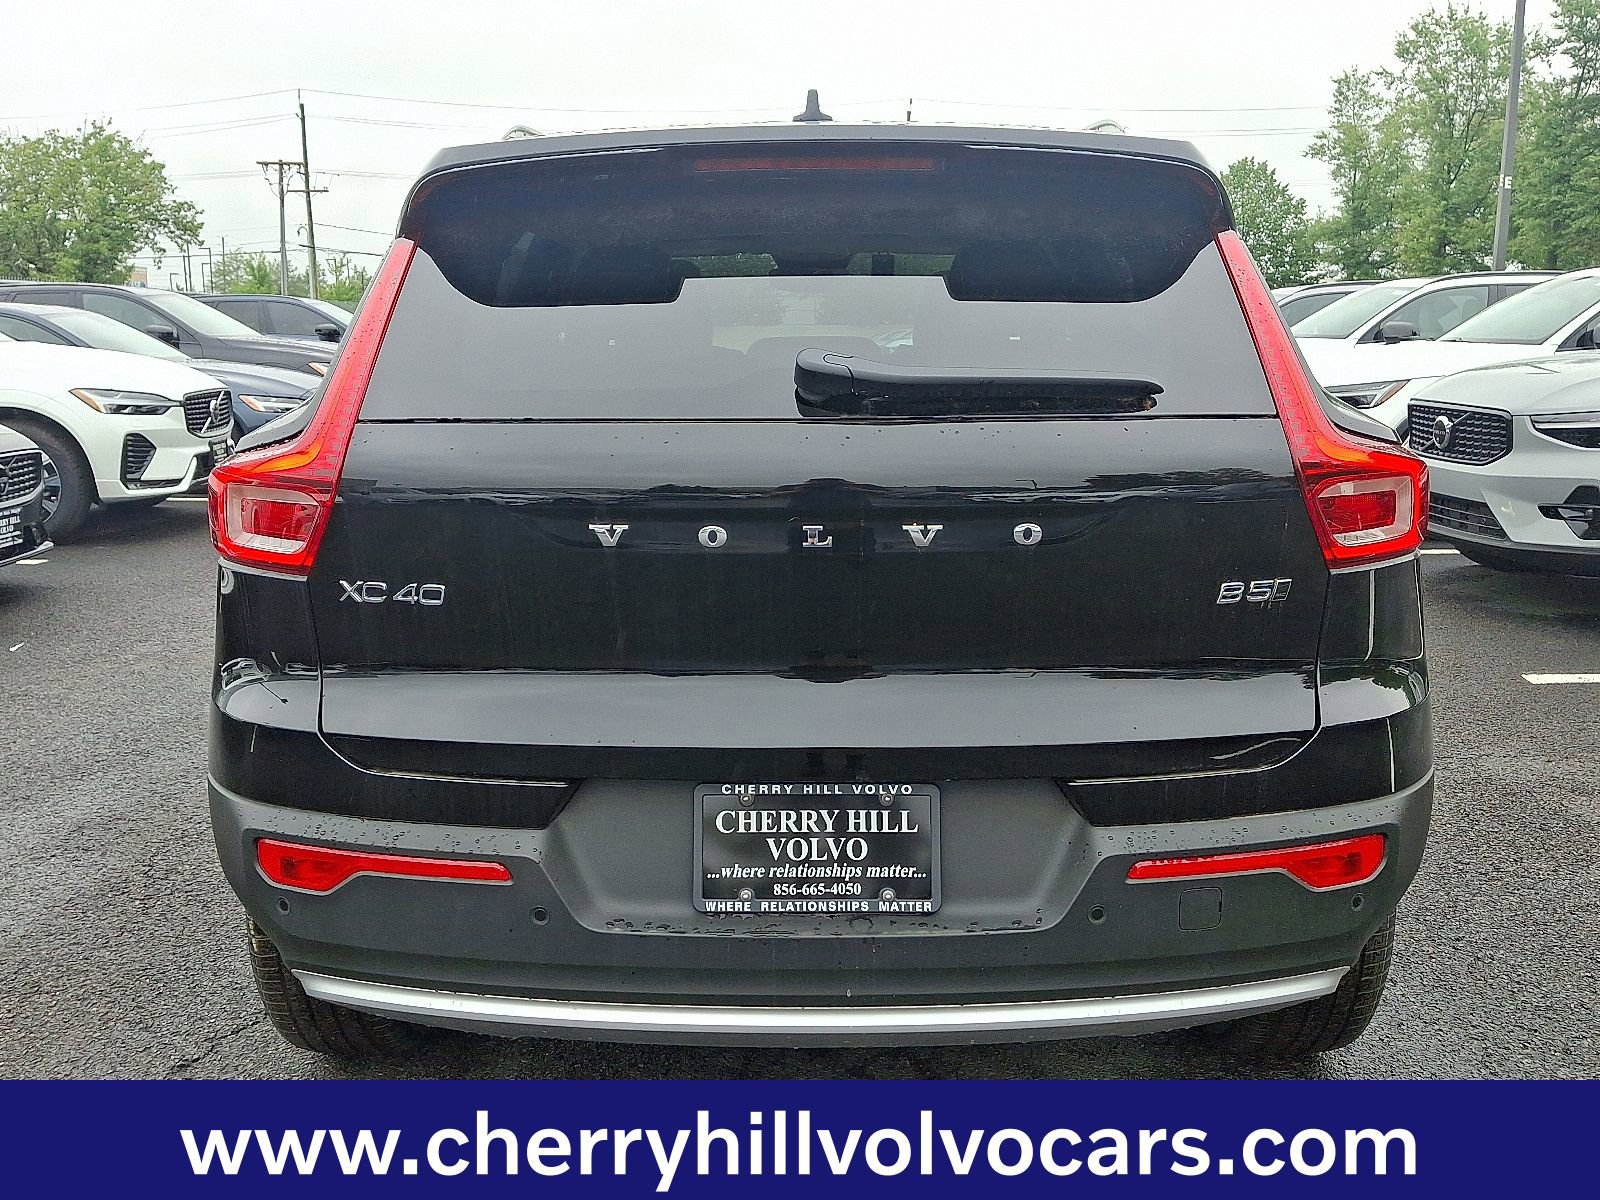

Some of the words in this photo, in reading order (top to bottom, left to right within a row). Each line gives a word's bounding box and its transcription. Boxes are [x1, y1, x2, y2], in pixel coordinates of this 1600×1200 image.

[588, 523, 1043, 548] VOLVO
[721, 784, 793, 795] CHERRY
[803, 784, 843, 795] HILL
[852, 784, 913, 795] VOLVO
[715, 810, 839, 834] CHERRY
[846, 809, 919, 834] HILL
[766, 837, 868, 861] VOLVO
[707, 864, 765, 879] ...where
[768, 863, 862, 881] relationships
[866, 865, 927, 879] matter...
[773, 883, 861, 896] 856-665-4050
[705, 901, 751, 912] WHERE
[761, 901, 869, 912] RELATIONSHIPS
[879, 901, 932, 912] MATTER
